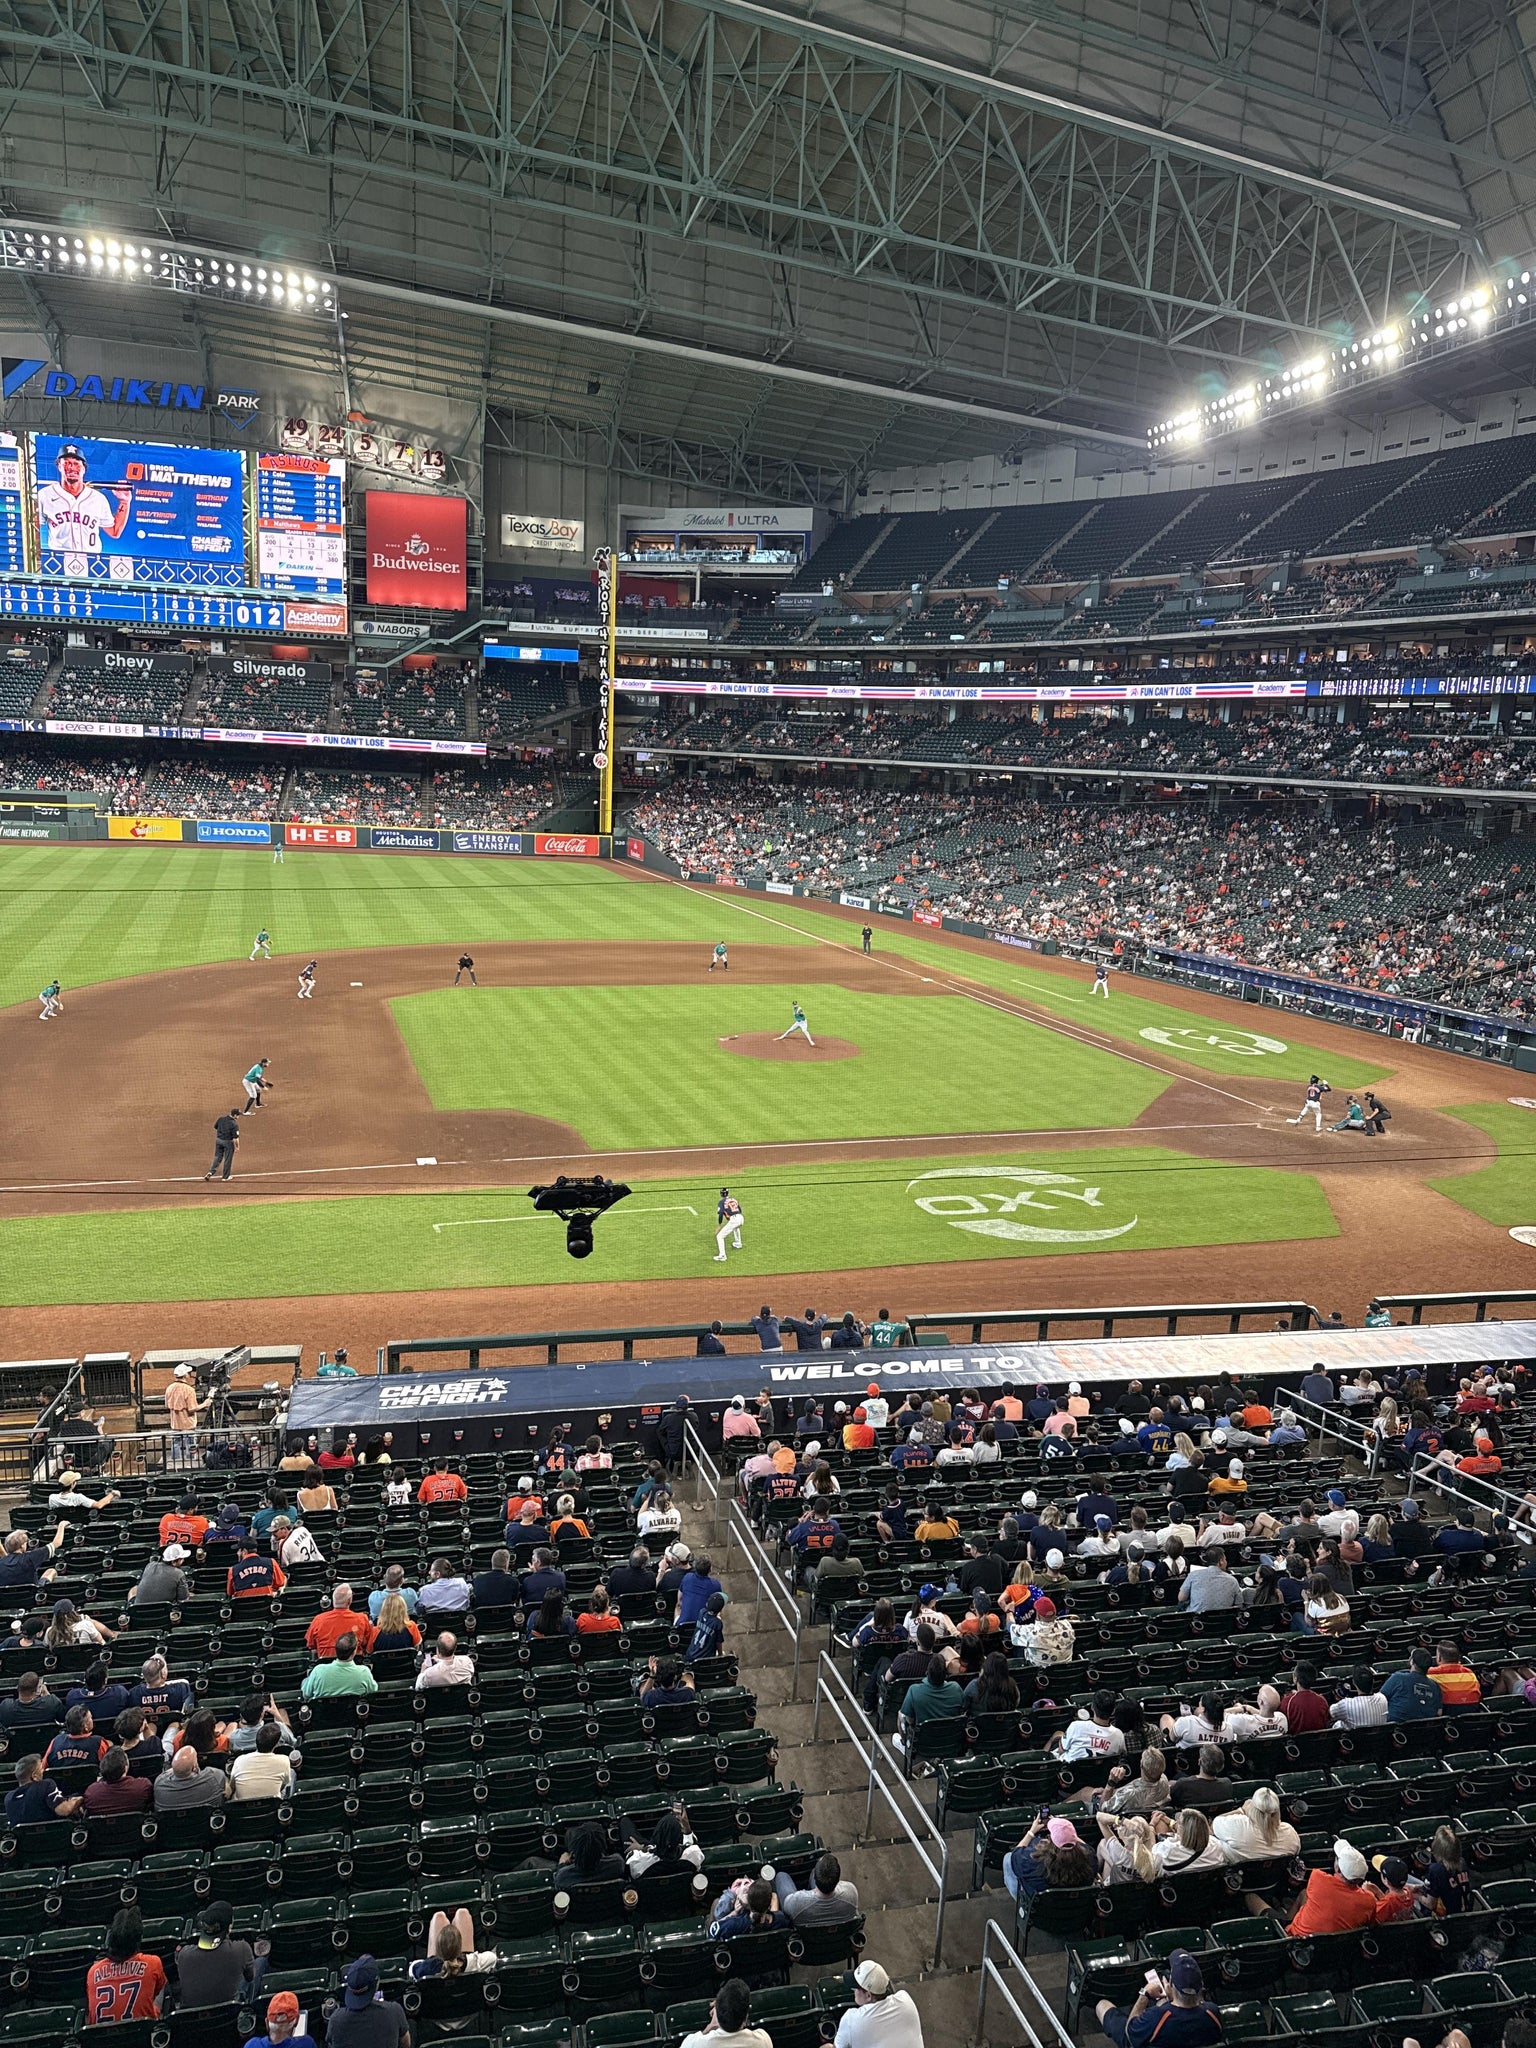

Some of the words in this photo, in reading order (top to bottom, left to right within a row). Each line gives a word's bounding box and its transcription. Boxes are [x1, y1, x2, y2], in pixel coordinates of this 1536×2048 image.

[45, 371, 204, 409] DAIKIN
[217, 394, 260, 410] PARK
[284, 418, 308, 435] 49
[319, 425, 342, 443] 24
[360, 434, 371, 450] 5
[395, 442, 406, 459] 7
[270, 455, 319, 472] ASTROS
[424, 450, 443, 467] 13
[150, 470, 232, 488] MATTHEWS
[196, 493, 229, 502] BIRTHDAY
[50, 510, 97, 529] ASTROS
[197, 515, 219, 523] DEBUT
[683, 513, 725, 527] Michelob
[738, 515, 779, 526] ULTRA
[507, 516, 546, 535] Texas
[550, 521, 579, 541] Bay
[89, 533, 96, 547] 0
[191, 536, 222, 546] CHASE
[532, 539, 553, 547] CREDIT
[555, 541, 576, 549] UNION
[204, 545, 231, 553] FIGHT
[286, 563, 314, 571] DAIKIN
[274, 583, 295, 591] Salazar
[5, 589, 11, 598] 3
[21, 590, 28, 599] 0
[37, 591, 44, 600] 0
[53, 592, 60, 602] 2
[69, 593, 76, 603] 0
[85, 594, 92, 604] 2
[152, 599, 158, 608] 7
[172, 600, 179, 609] 8
[187, 601, 195, 610] 0
[203, 602, 210, 611] 2
[219, 603, 225, 612] 3
[5, 601, 12, 611] 0
[21, 602, 28, 611] 0
[38, 603, 43, 612] 1
[53, 604, 60, 614] 0
[69, 605, 76, 615] 0
[85, 606, 92, 616] 2
[152, 610, 159, 620] 3
[172, 612, 179, 621] 4
[188, 613, 195, 622] 0
[203, 614, 210, 623] 2
[219, 615, 226, 624] 2
[237, 605, 250, 624] 0
[252, 607, 262, 625] 1
[268, 607, 281, 626] 2
[287, 609, 341, 627] Academy
[377, 624, 421, 636] NABORS
[599, 627, 608, 642] 4
[105, 653, 154, 669] Chevy
[599, 645, 609, 680] THA
[233, 660, 306, 677] Silverado
[621, 680, 647, 688] Academy
[720, 684, 733, 692] FUN
[734, 685, 753, 693] CAN'T
[832, 687, 856, 695] Academy
[1140, 687, 1153, 696] FUN
[1154, 687, 1174, 696] CAN'T
[1175, 686, 1193, 695] LOSE
[1257, 684, 1286, 693] Academy
[1439, 681, 1445, 691] R
[1461, 681, 1468, 690] H
[1484, 680, 1490, 690] E
[1507, 680, 1513, 690] L
[929, 689, 941, 697] FUN
[942, 689, 961, 697] CAN'T
[1040, 689, 1066, 697] Academy
[599, 684, 609, 751] CHIKIN
[25, 720, 35, 731] K
[65, 723, 94, 732] ezee
[99, 725, 137, 734] FIBER
[225, 730, 257, 740] Academy
[323, 736, 339, 745] FUN
[340, 737, 362, 746] CAN'T
[365, 738, 385, 747] LOSE
[436, 741, 466, 751] Academy
[3, 828, 20, 837] HOME
[21, 829, 50, 838] NETWORK
[213, 828, 269, 837] HONDA
[377, 832, 434, 847] Methodist
[472, 834, 511, 843] ENERGY
[472, 841, 519, 851] TRANSFER
[544, 837, 586, 852] Coca-Cola
[914, 1187, 1104, 1215] OXY
[876, 1332, 891, 1344] 44
[770, 1358, 963, 1381] WELCOME
[970, 1356, 1025, 1370] TO
[379, 1382, 481, 1397] CHASE
[379, 1397, 421, 1406] THE
[420, 1390, 508, 1405] FIGHT
[1152, 1439, 1169, 1452] 44
[1427, 1438, 1440, 1452] 2
[546, 1454, 565, 1471] 44
[771, 1478, 798, 1487] ALTUVE
[434, 1489, 454, 1501] 27
[773, 1488, 795, 1498] 27
[648, 1517, 678, 1528] ALVAREZ
[809, 1525, 835, 1533] VALDEZ
[167, 1531, 191, 1545] 22
[294, 1532, 308, 1547] RYAN
[300, 1540, 318, 1562] 34
[239, 1566, 268, 1580] ASTROS
[913, 1614, 941, 1627] CORREA
[142, 1693, 169, 1705] ORBIT
[1090, 1736, 1112, 1751] TENG
[56, 1749, 89, 1760] ASTROS
[94, 1961, 148, 1984] ALTUVE
[96, 1980, 142, 2023] 27
